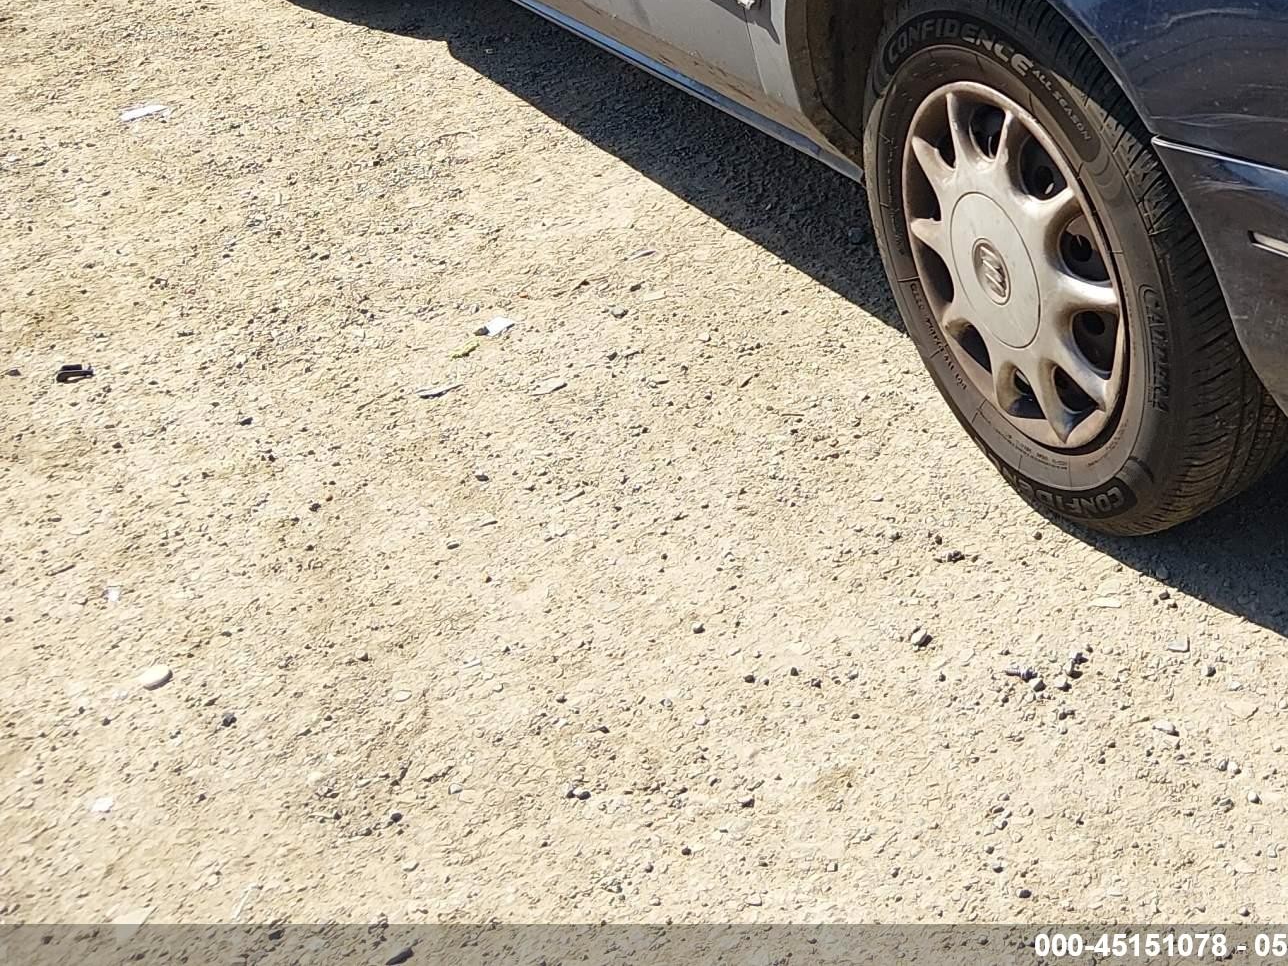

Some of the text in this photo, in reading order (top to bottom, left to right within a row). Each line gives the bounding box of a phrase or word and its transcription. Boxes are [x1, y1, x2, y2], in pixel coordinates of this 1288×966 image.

[888, 18, 1092, 141] CONFIDENCE ALL SEASON
